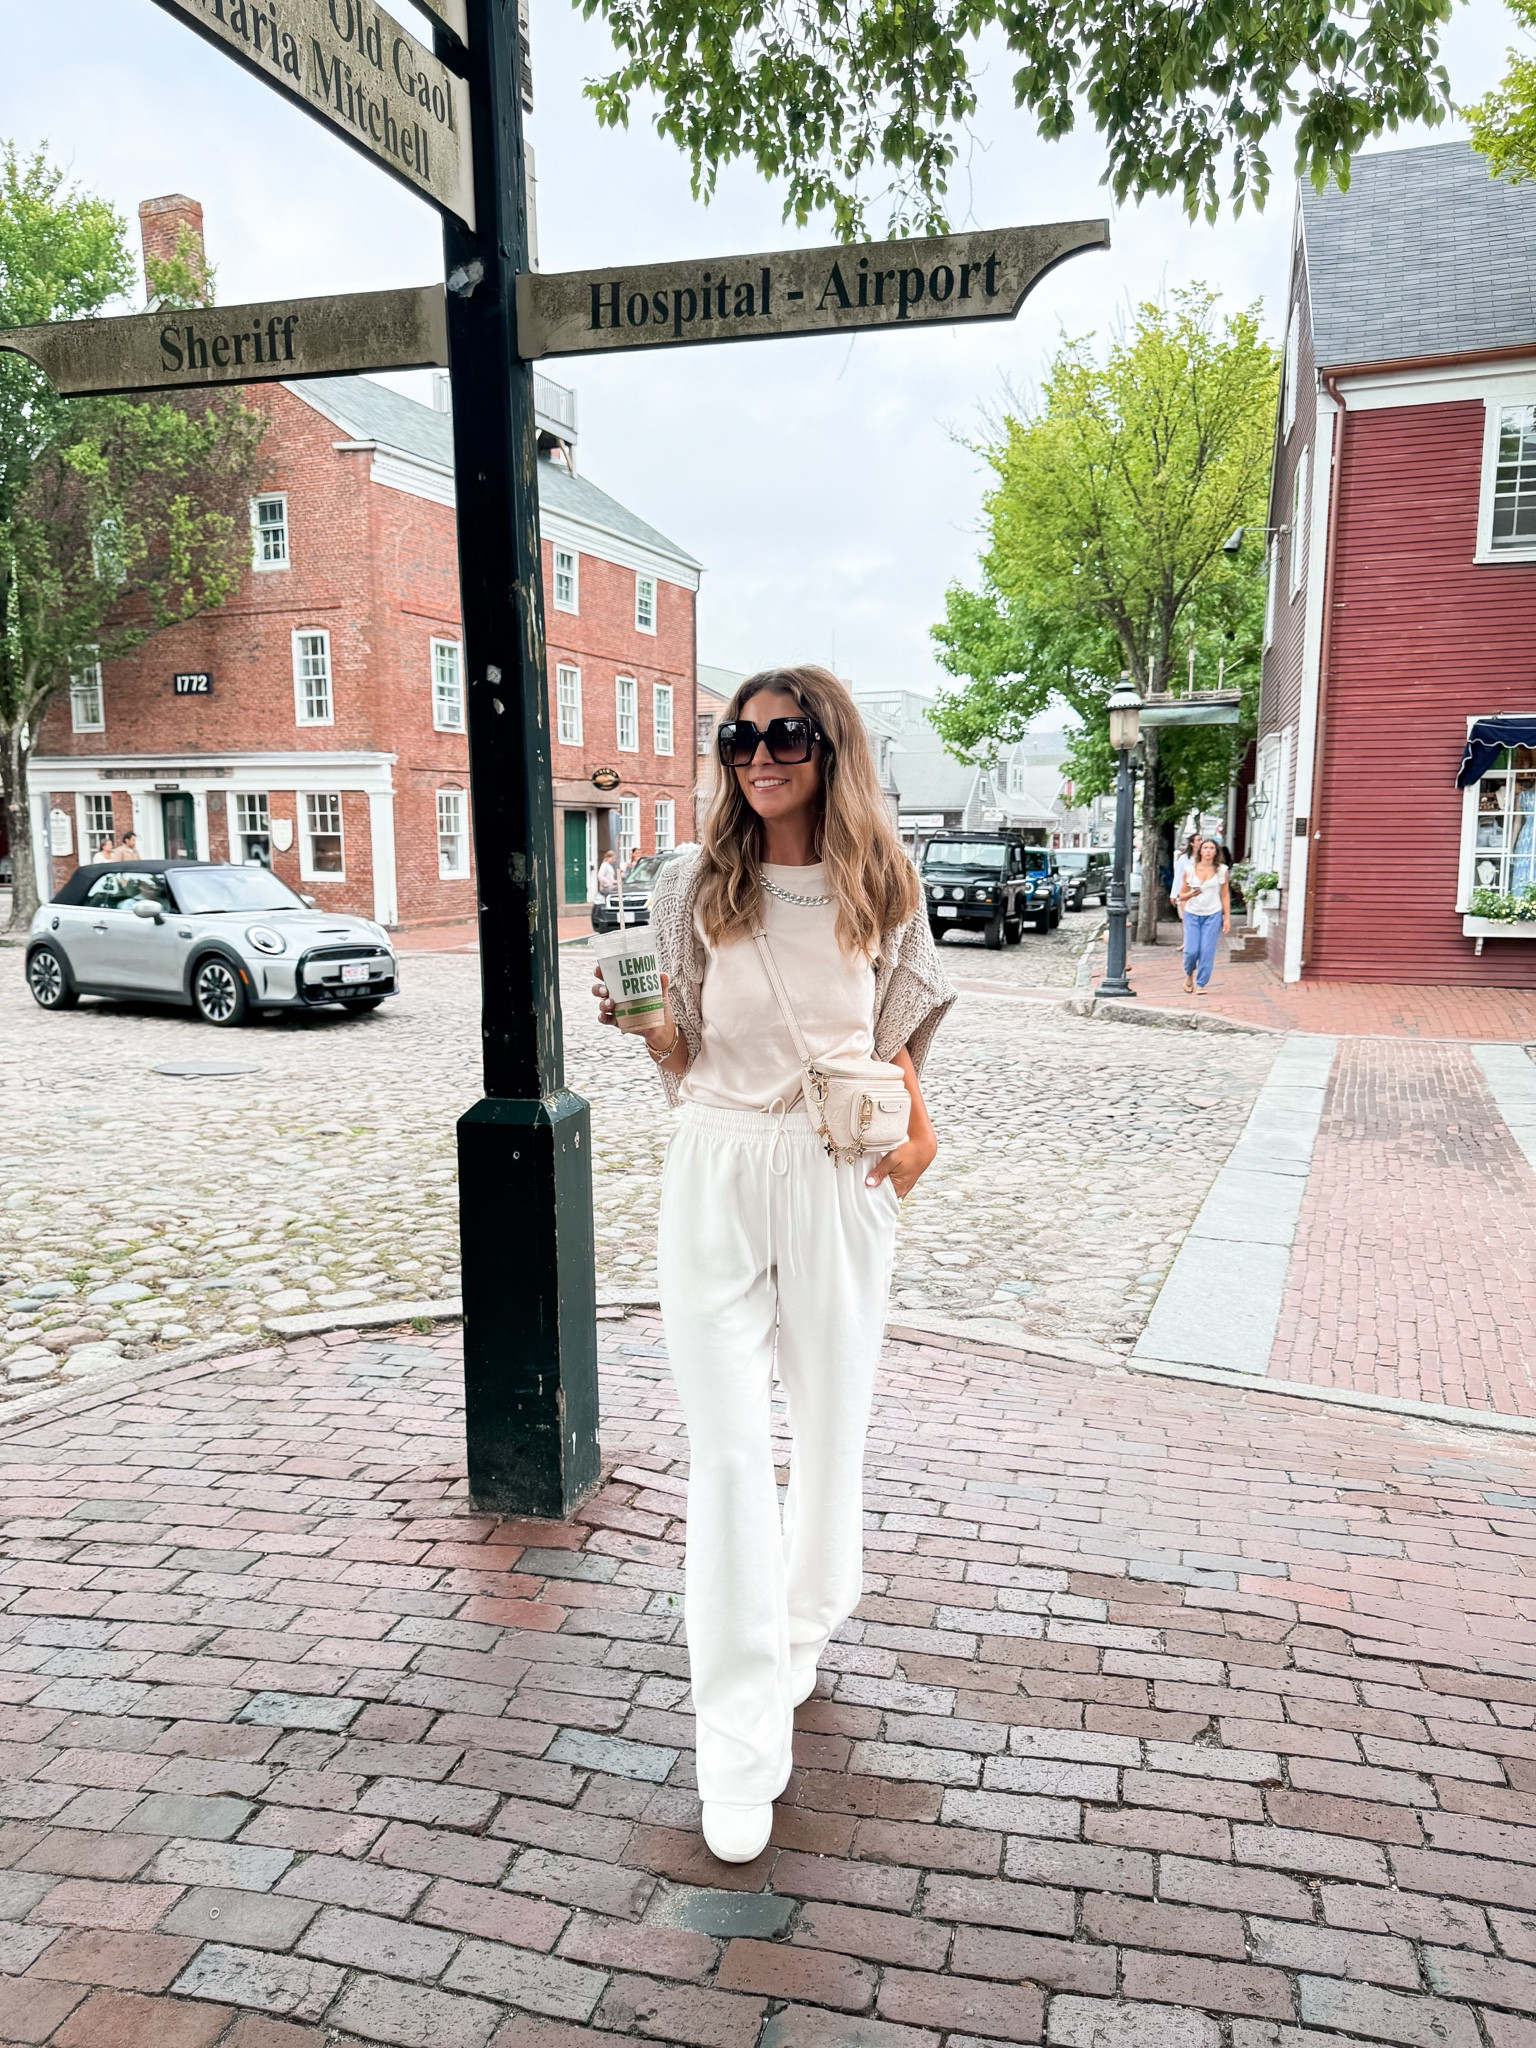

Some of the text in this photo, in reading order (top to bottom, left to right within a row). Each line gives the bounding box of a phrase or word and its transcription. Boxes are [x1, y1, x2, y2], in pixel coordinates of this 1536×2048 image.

[328, 0, 456, 134] Old Gaol
[309, 34, 431, 182] Mitchell
[587, 267, 773, 338] Hospital
[815, 249, 1002, 320] Airport
[160, 315, 300, 373] Sheriff
[176, 674, 208, 693] 1772
[618, 954, 657, 977] LEMON
[621, 973, 660, 996] PRESS
